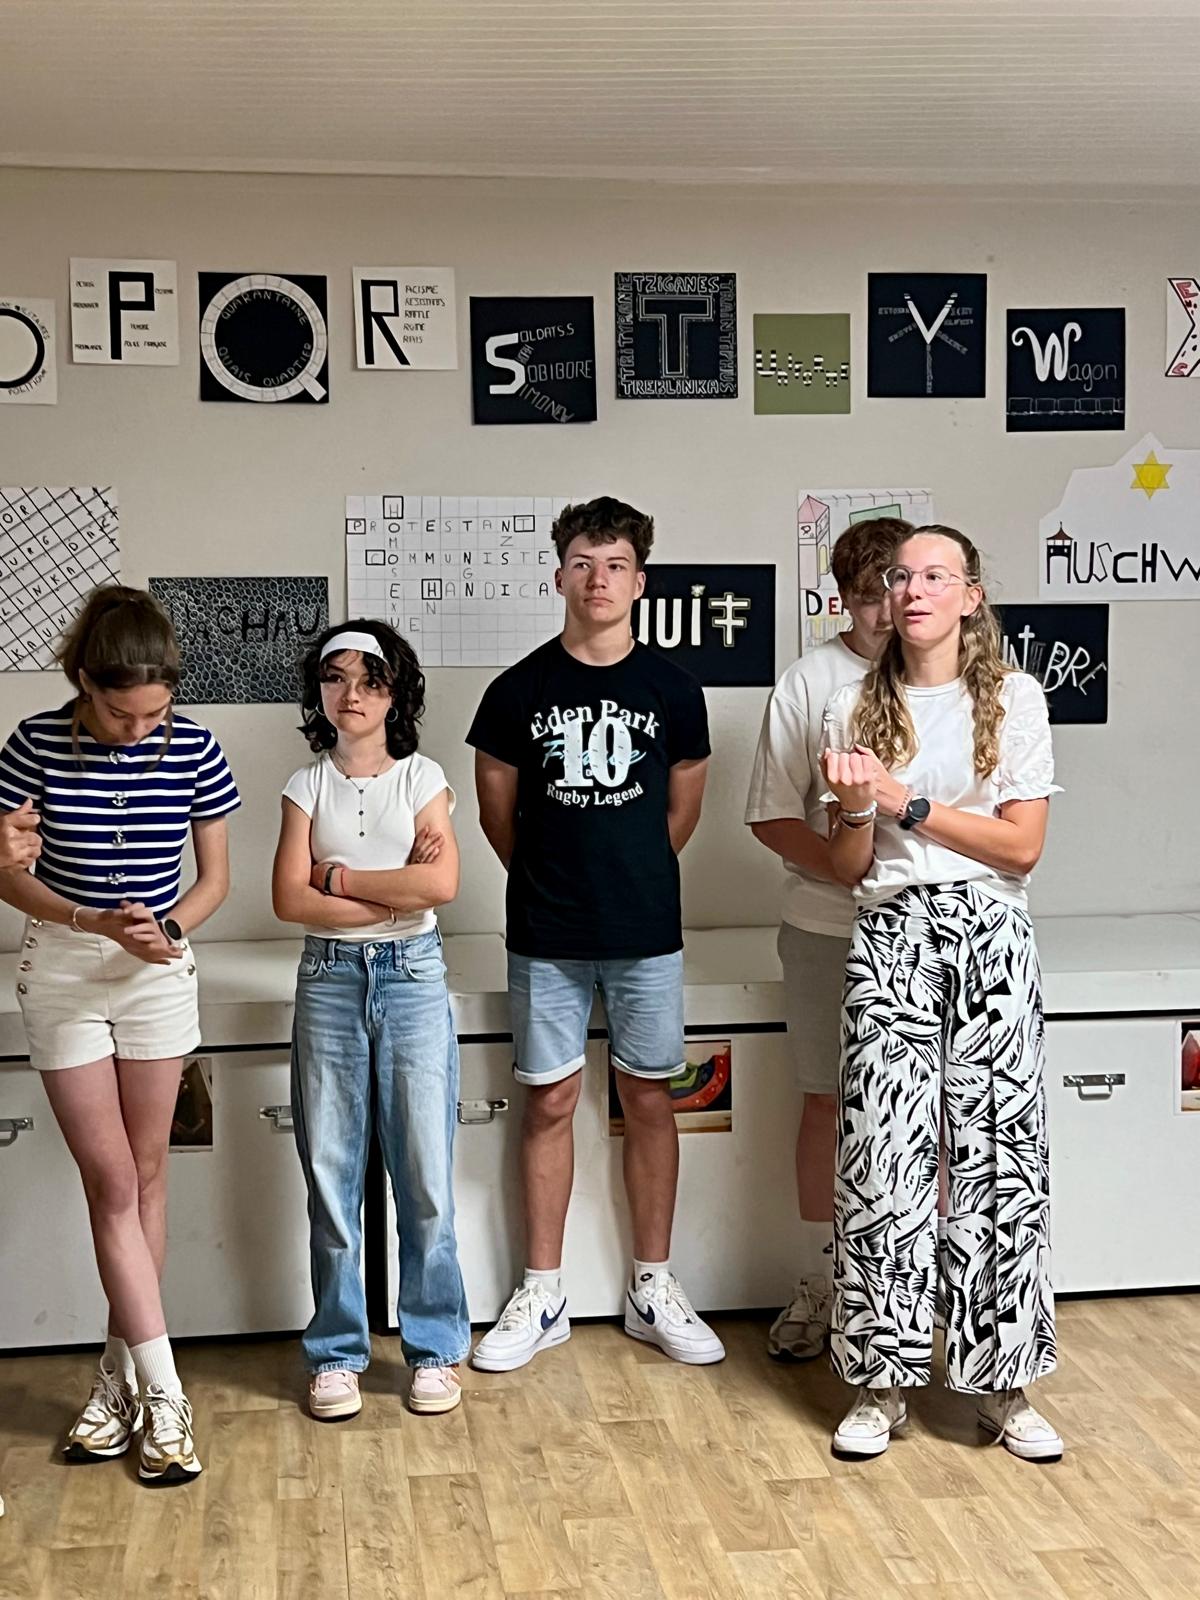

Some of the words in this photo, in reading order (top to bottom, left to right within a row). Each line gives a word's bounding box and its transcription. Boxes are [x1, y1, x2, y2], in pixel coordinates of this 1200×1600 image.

[108, 271, 155, 360] P
[361, 279, 411, 365] R
[1011, 321, 1118, 392] Wagon
[806, 590, 843, 616] DE
[530, 706, 594, 740] Eden
[600, 699, 660, 739] Park
[554, 716, 633, 788] 10
[546, 782, 590, 808] Rugby
[593, 782, 644, 807] Legend
